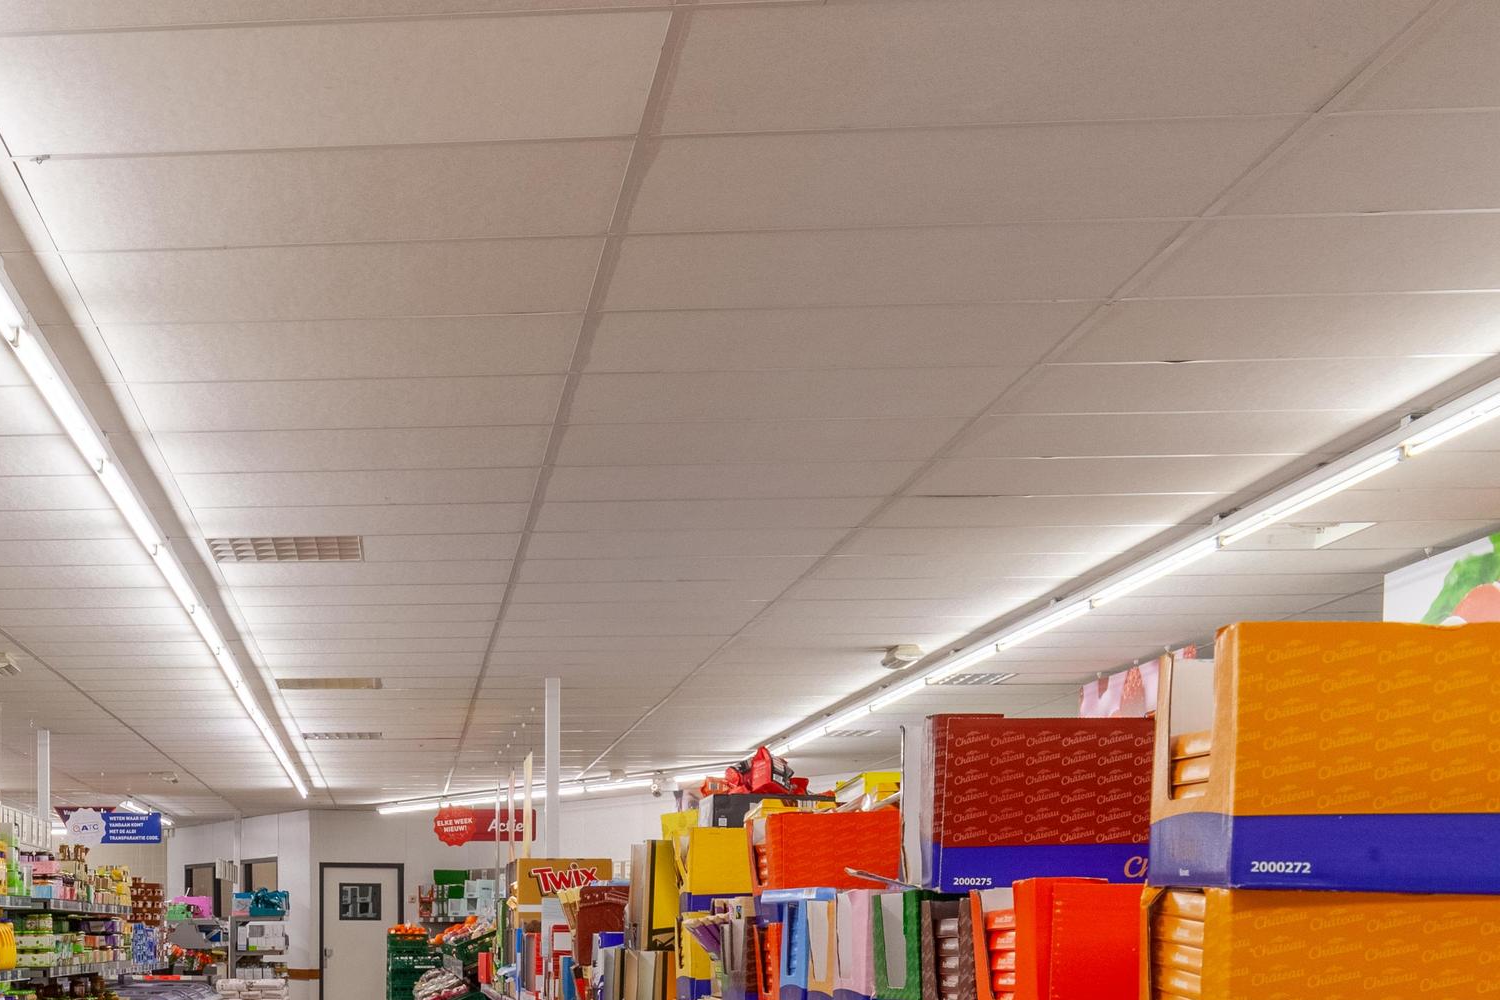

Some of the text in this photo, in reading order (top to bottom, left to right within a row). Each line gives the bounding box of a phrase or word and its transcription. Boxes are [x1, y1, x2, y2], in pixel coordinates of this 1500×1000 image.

[436, 817, 473, 827] ELKE WEEK
[443, 825, 468, 833] NIEUW!
[1250, 860, 1312, 875] 2000272
[953, 877, 992, 887] 2000275
